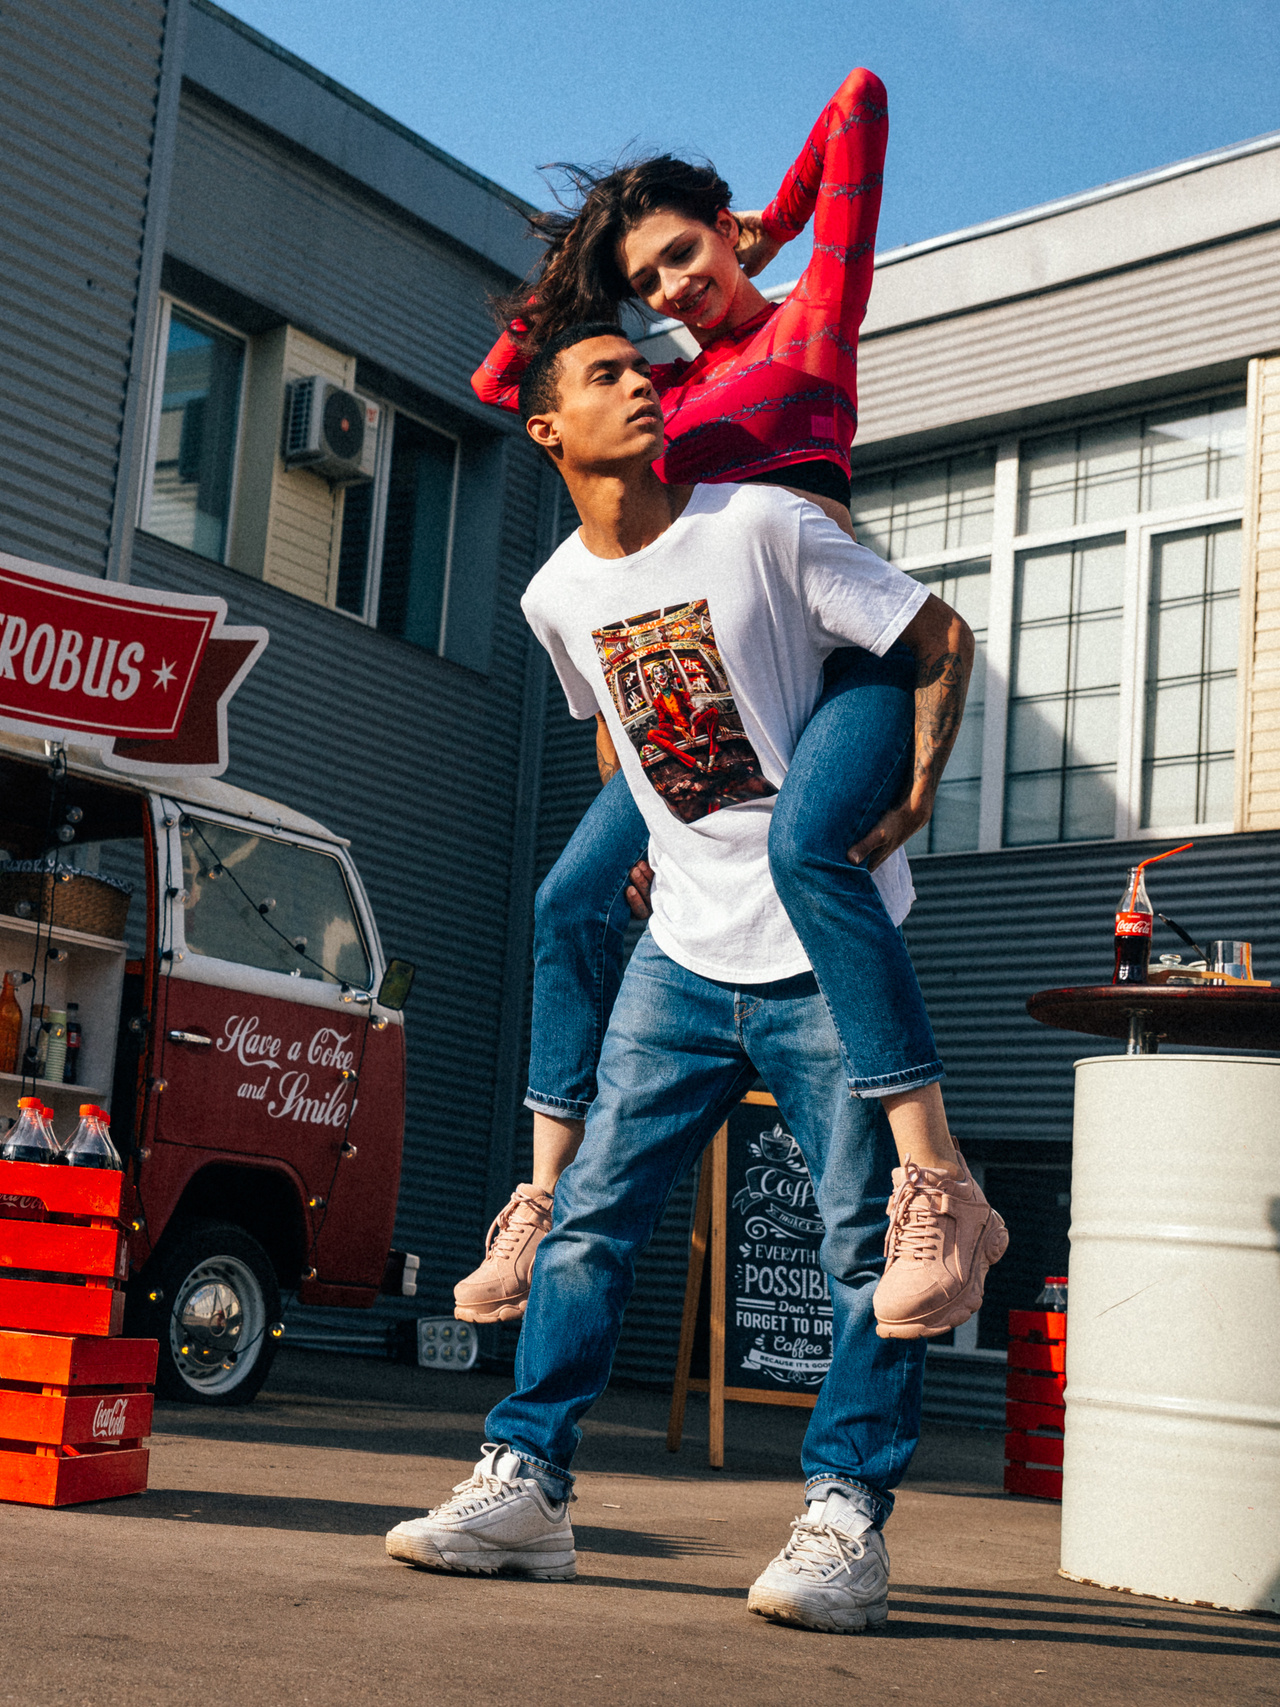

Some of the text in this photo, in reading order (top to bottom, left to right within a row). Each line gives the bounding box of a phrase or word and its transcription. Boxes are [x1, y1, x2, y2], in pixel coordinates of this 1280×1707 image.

[1116, 920, 1150, 934] Coca-Cola
[216, 1015, 354, 1070] Have a Coke
[237, 1071, 358, 1128] and Smile!
[761, 1169, 814, 1207] Coff
[755, 1244, 821, 1265] EVERYTHI
[745, 1264, 831, 1300] POSSIBL
[778, 1301, 815, 1315] Don't
[736, 1311, 832, 1336] FORGET TO DR
[773, 1335, 823, 1358] Coffee
[759, 1355, 793, 1367] BECAUSE
